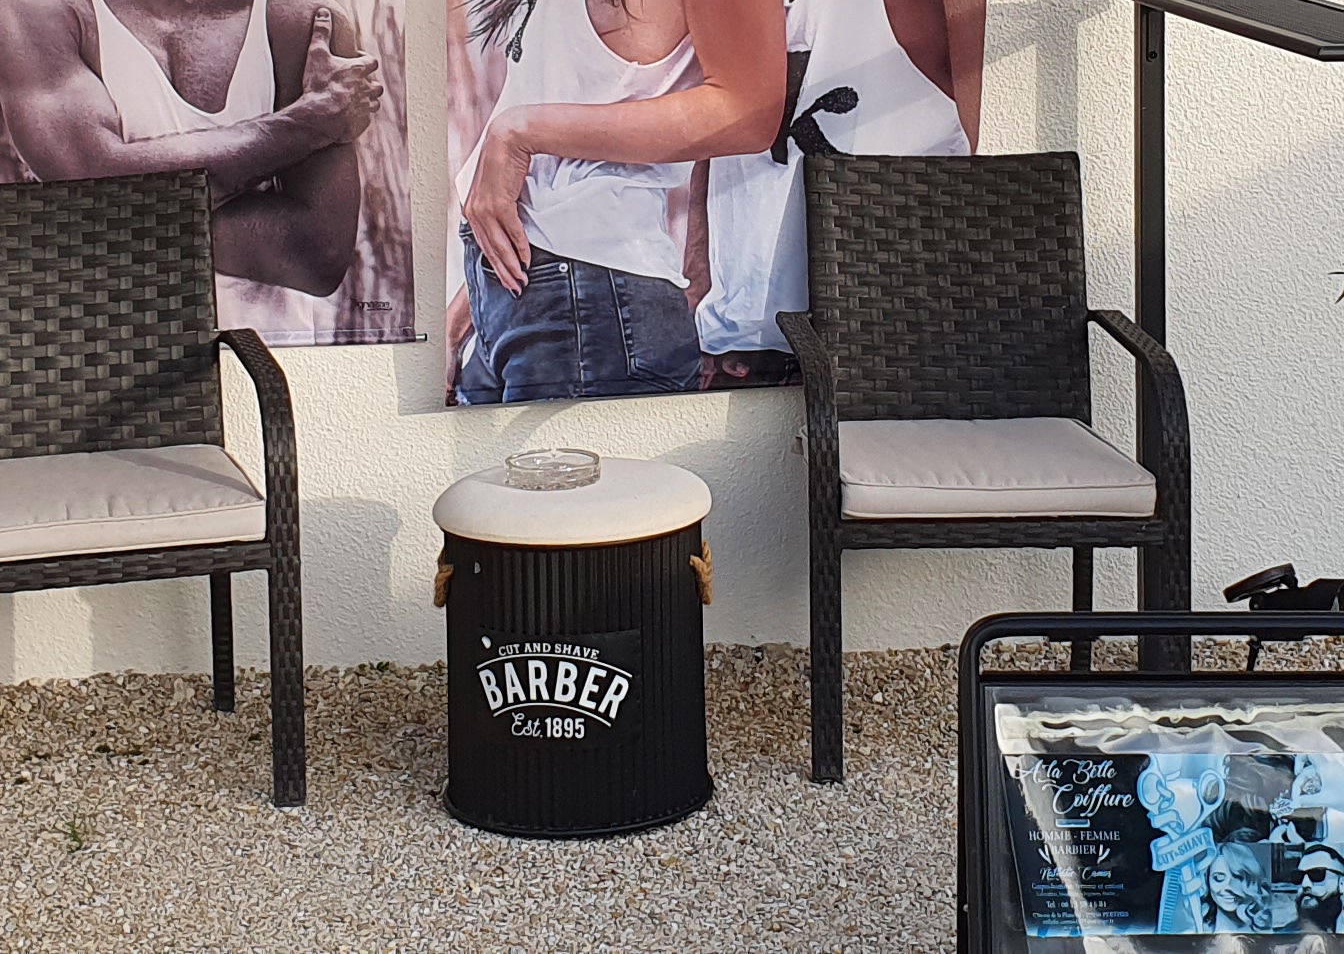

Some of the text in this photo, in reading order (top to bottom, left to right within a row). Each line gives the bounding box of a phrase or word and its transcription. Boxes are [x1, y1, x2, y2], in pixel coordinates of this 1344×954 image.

[498, 642, 600, 660] CUT AND SHAVE
[478, 659, 630, 720] BARBER
[511, 712, 585, 739] Est. 1895
[1043, 759, 1062, 779] la
[1063, 759, 1117, 784] Belle
[1042, 783, 1135, 817] Coiffure
[1029, 830, 1071, 841] HOMME
[1080, 830, 1121, 841] FEMME
[1177, 832, 1209, 856] SHAVE
[1052, 844, 1097, 855] BARBIER
